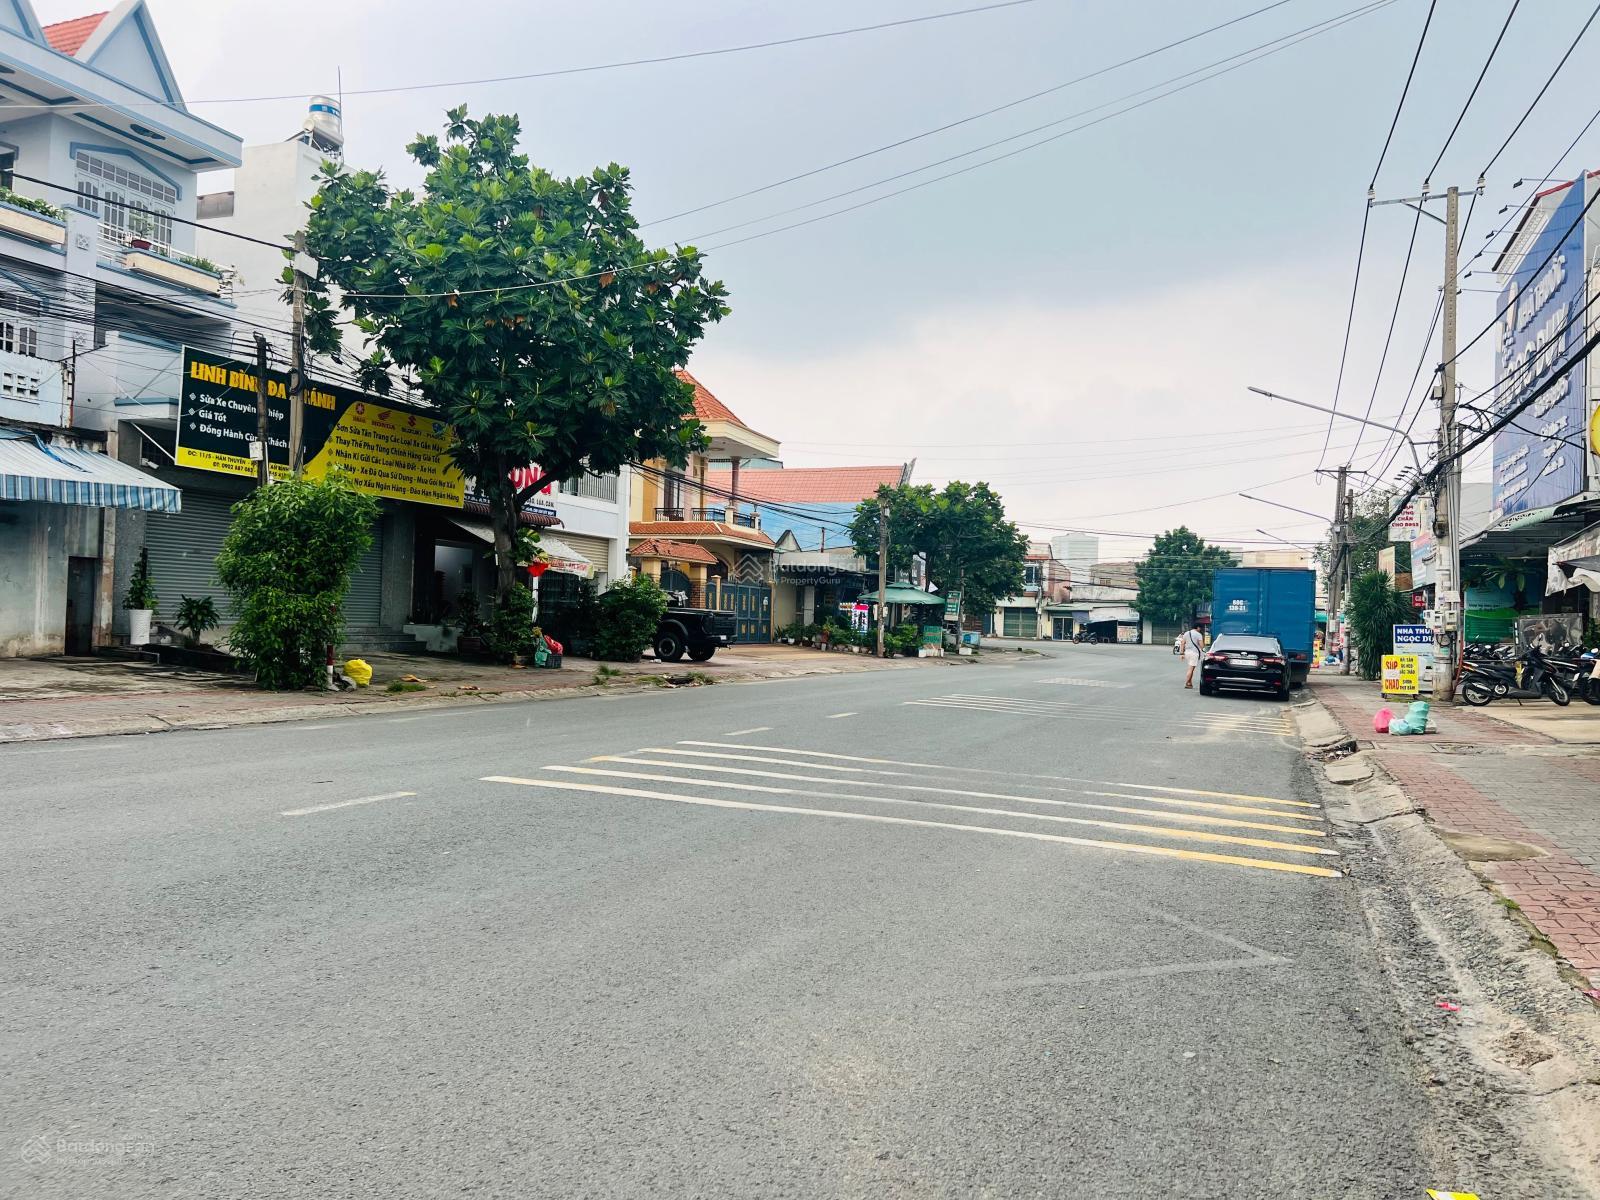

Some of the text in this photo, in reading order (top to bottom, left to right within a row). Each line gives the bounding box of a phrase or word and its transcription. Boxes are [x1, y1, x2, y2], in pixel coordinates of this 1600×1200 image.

[191, 361, 226, 385] LINH
[268, 380, 286, 399] ĐA
[216, 398, 226, 407] Xe
[228, 400, 257, 413] Chuyên
[198, 409, 227, 422] Giá Tốt
[200, 424, 222, 437] Đồng
[223, 428, 244, 440] Hành
[245, 432, 258, 442] Cùn
